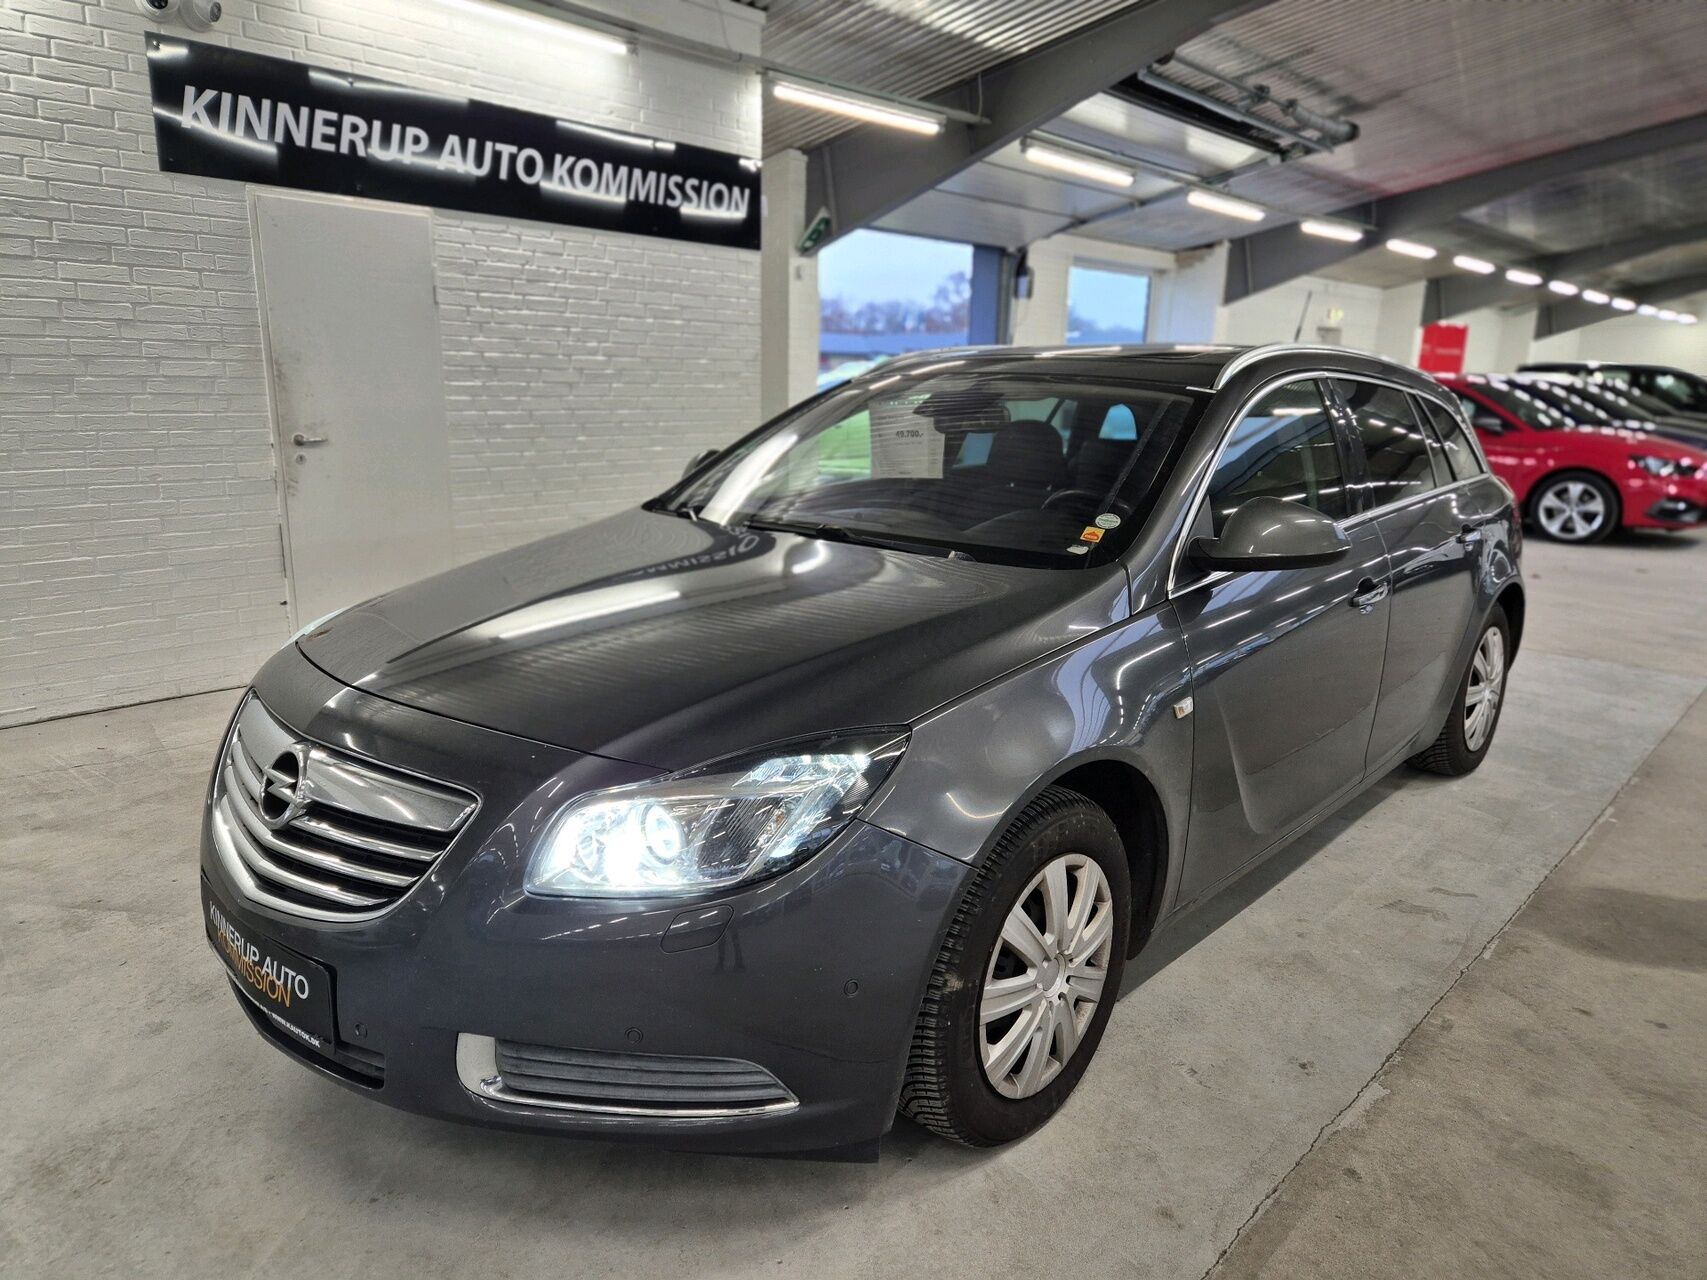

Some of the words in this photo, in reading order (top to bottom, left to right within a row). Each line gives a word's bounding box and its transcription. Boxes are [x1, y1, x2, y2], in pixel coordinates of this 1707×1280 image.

[181, 84, 430, 166] KINNERUP
[438, 133, 544, 184] AUTO
[551, 155, 751, 215] KOMMISSION
[209, 900, 260, 965] KINNERUP
[261, 956, 309, 1000] AUTO
